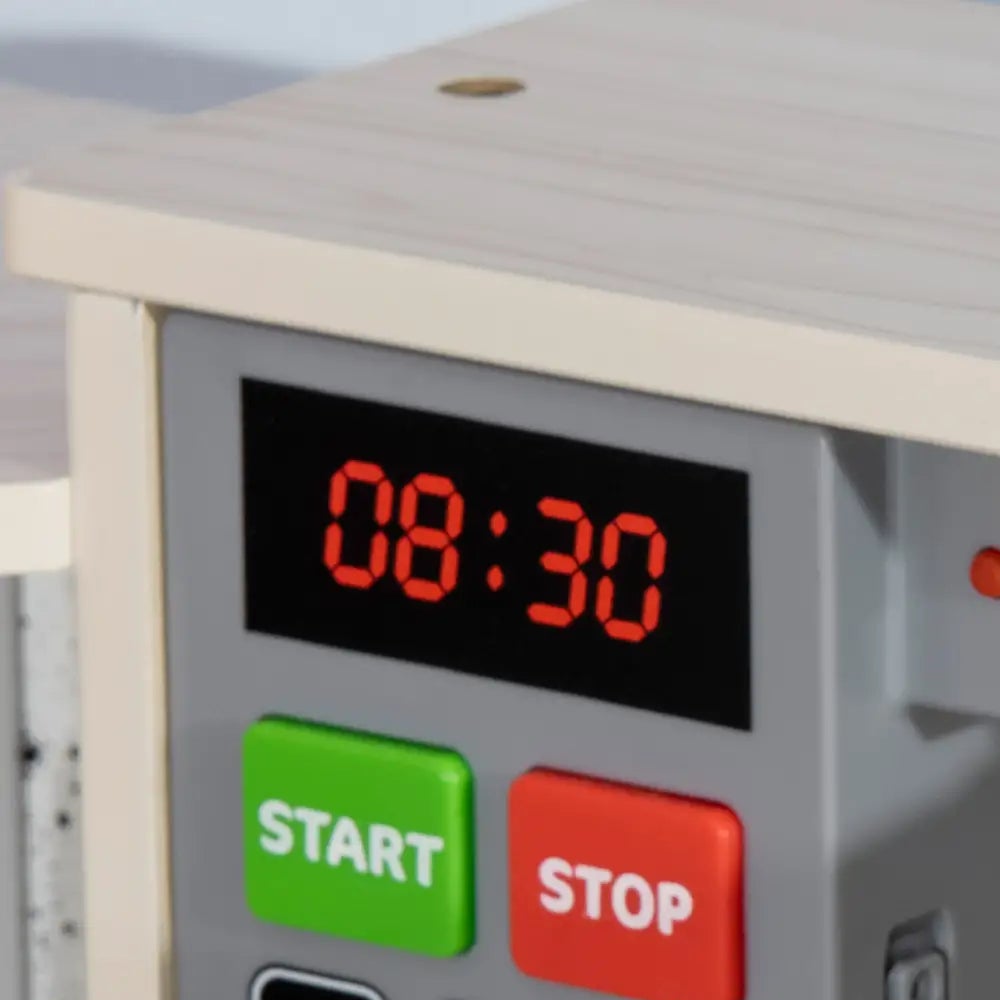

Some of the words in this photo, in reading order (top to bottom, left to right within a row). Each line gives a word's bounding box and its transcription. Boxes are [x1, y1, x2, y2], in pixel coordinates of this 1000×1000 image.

[323, 459, 667, 642] 08:30
[258, 799, 445, 888] START
[537, 857, 694, 936] STOP
